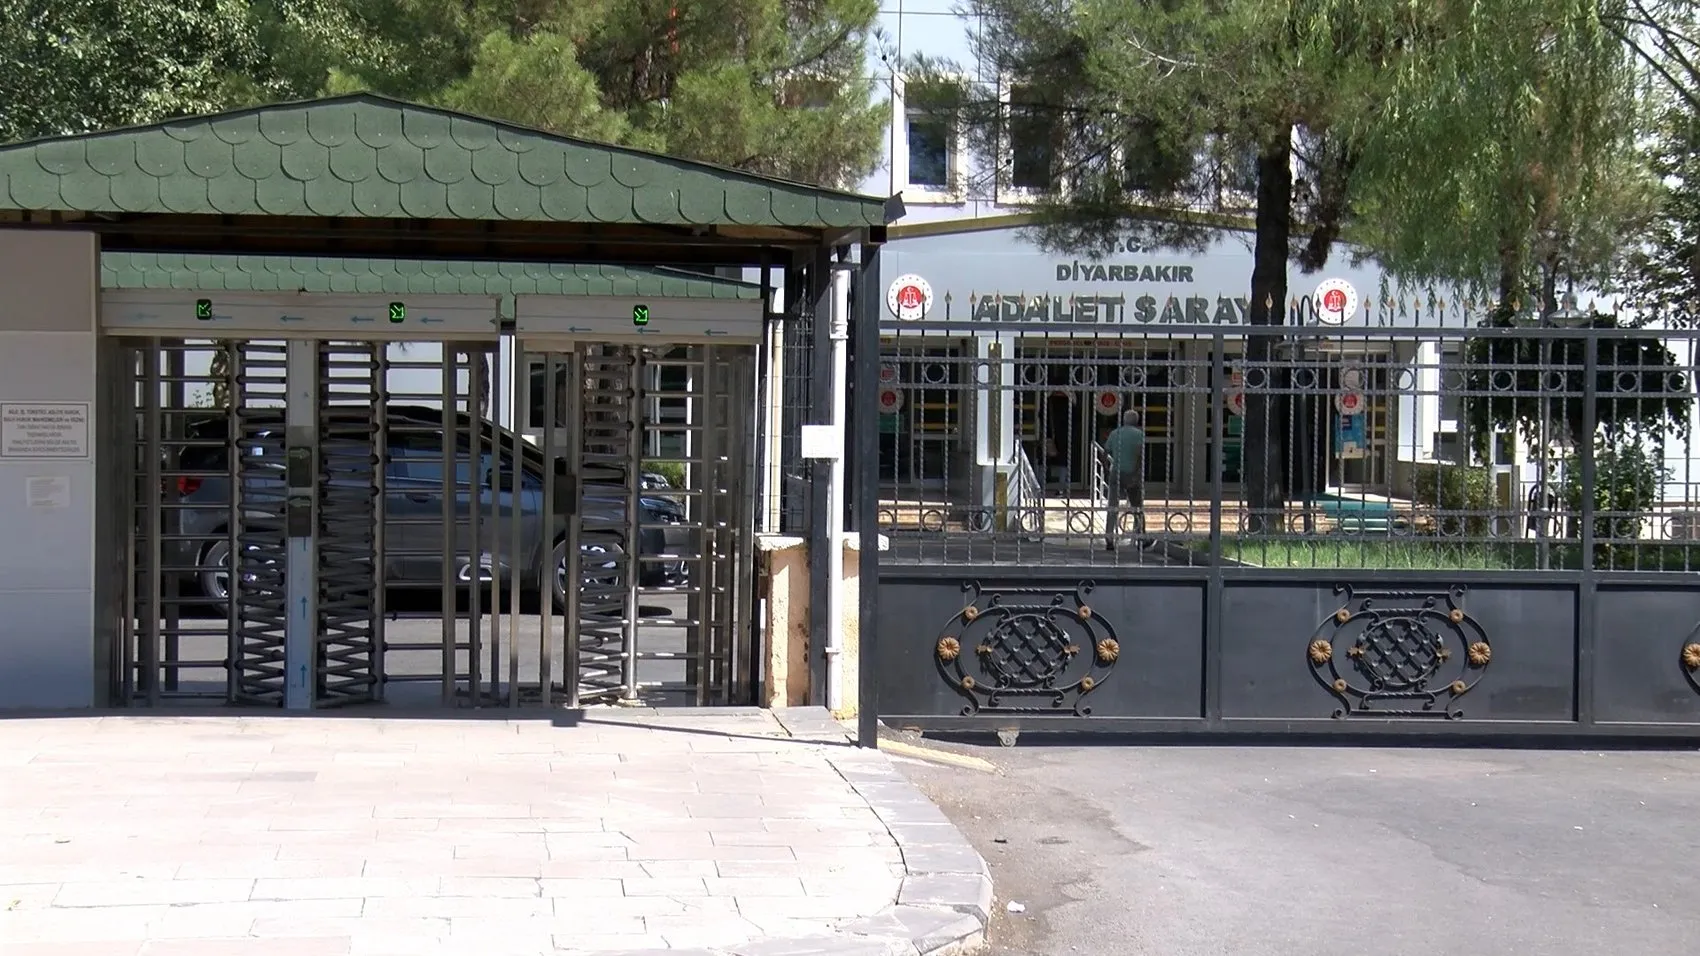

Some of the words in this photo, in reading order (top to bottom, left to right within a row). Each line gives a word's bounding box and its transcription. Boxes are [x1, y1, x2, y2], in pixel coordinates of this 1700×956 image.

[1056, 260, 1194, 283] DİYARBAKIR
[973, 294, 1124, 322] ADALET
[1134, 295, 1253, 324] SARAY
